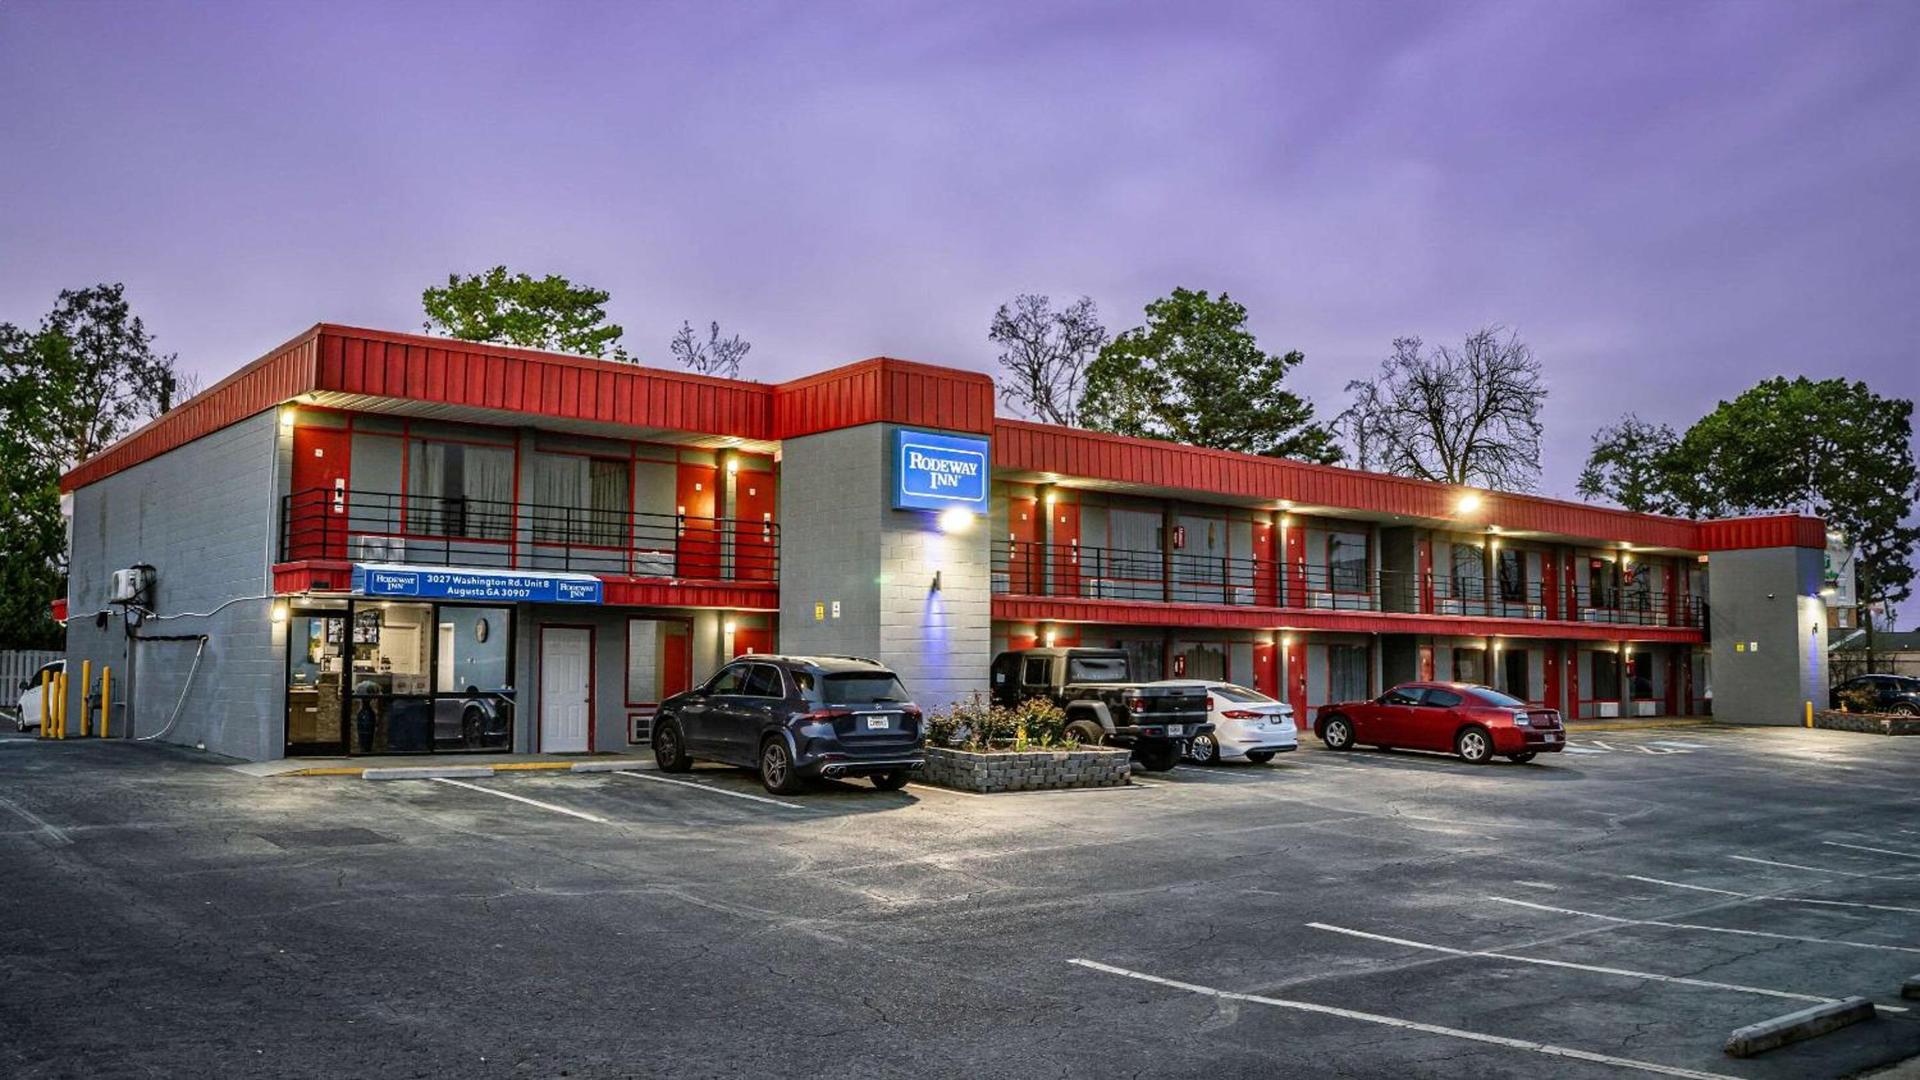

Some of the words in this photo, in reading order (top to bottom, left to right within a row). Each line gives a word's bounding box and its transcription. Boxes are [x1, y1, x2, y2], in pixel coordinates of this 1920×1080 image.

[909, 452, 978, 476] RODEWAY
[930, 472, 958, 490] INN
[376, 574, 415, 585] RODEWAY
[427, 575, 451, 584] 3027
[452, 576, 506, 588] Washington
[507, 579, 522, 587] Rd.
[524, 579, 543, 588] Unit
[387, 583, 404, 591] INN
[447, 586, 484, 598] Augusta
[486, 588, 500, 597] GA
[501, 588, 531, 597] 30907
